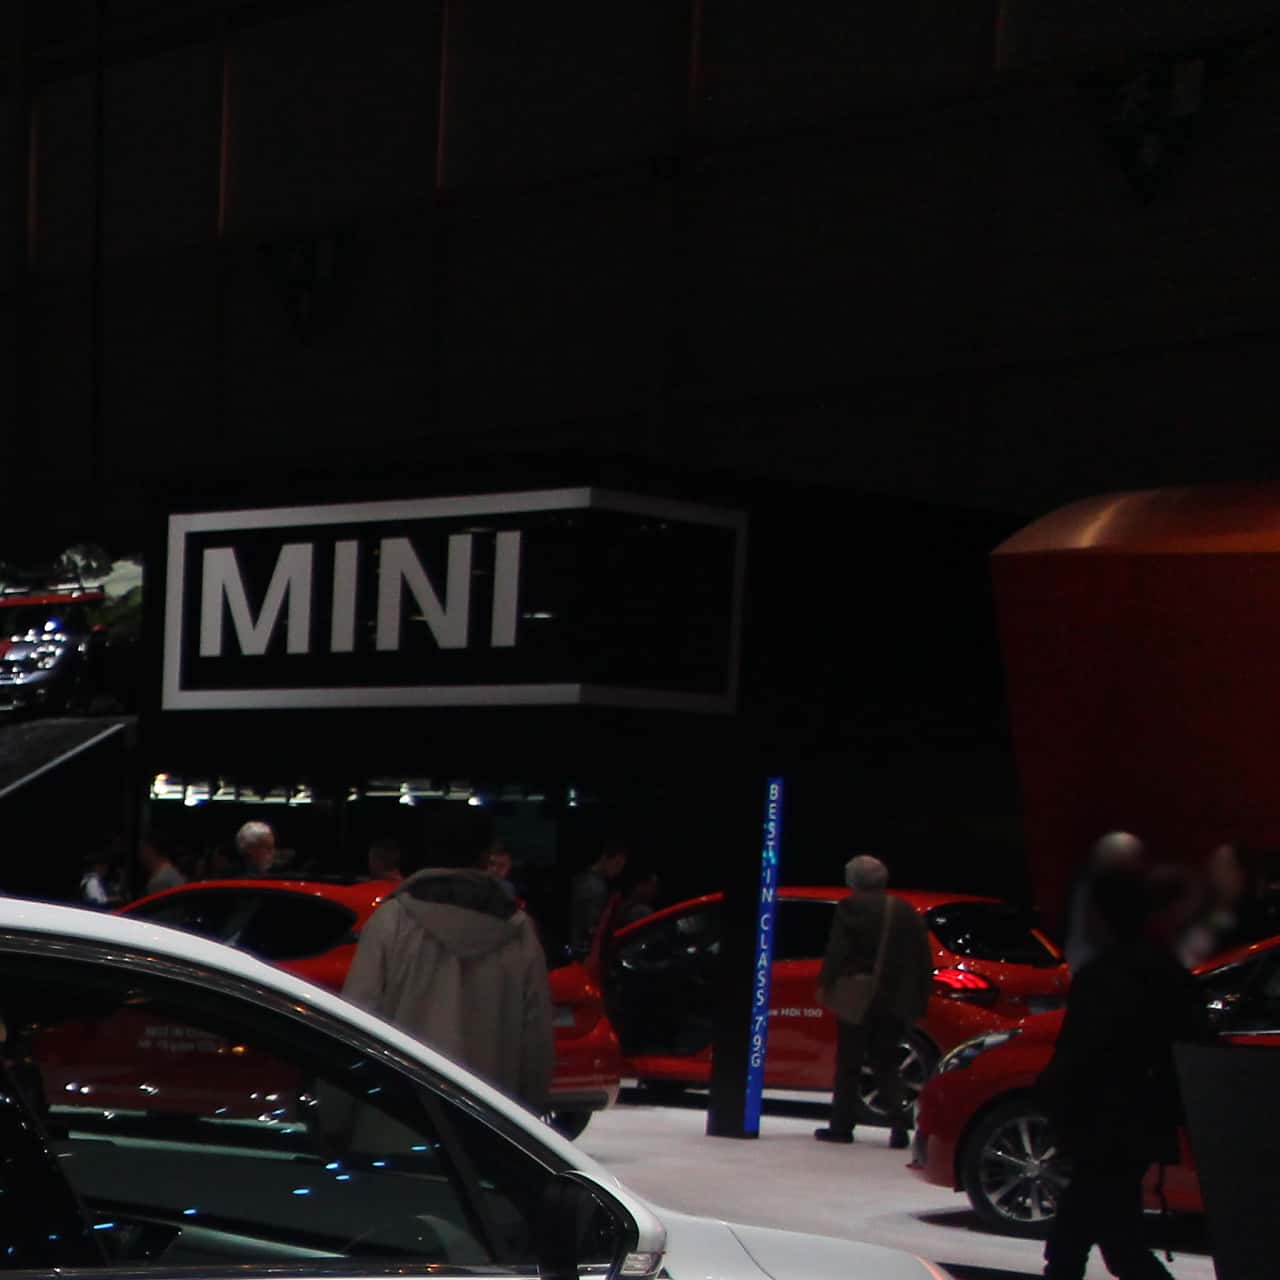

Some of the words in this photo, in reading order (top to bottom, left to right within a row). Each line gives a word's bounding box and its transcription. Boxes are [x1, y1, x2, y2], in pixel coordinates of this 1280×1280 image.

[200, 531, 521, 657] MINI
[765, 783, 779, 860] BEST
[762, 868, 774, 904] IN
[756, 914, 771, 1006] CLASS
